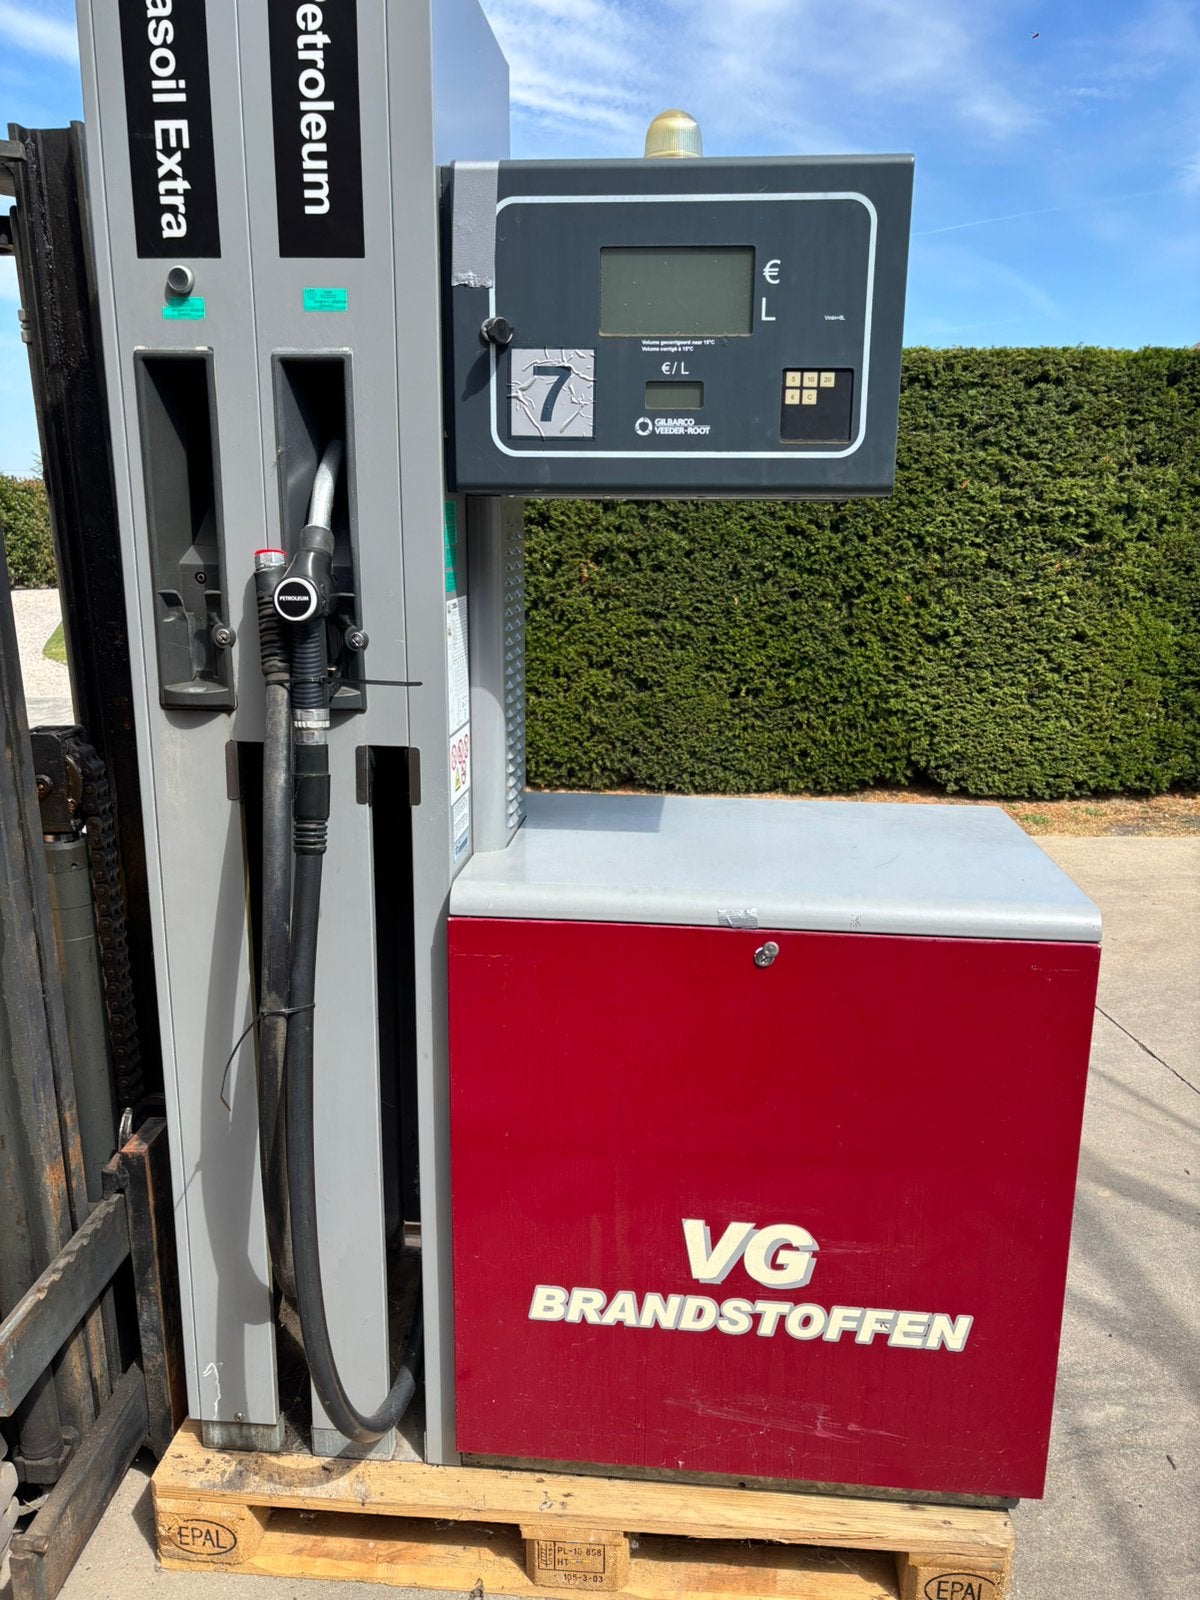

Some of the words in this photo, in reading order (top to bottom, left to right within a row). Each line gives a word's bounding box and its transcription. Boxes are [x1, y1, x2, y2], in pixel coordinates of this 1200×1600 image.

[296, 0, 335, 215] etroleum
[153, 119, 192, 240] Extra
[762, 259, 781, 285] €
[761, 297, 777, 321] L
[533, 366, 572, 422] 7
[654, 418, 695, 426] GILBARCO
[654, 426, 711, 435] VEEDER-ROOT
[681, 1217, 821, 1290] VG
[528, 1284, 974, 1352] BRANDSTOFFEN
[178, 1527, 227, 1549] EPAL
[557, 1558, 569, 1566] HT
